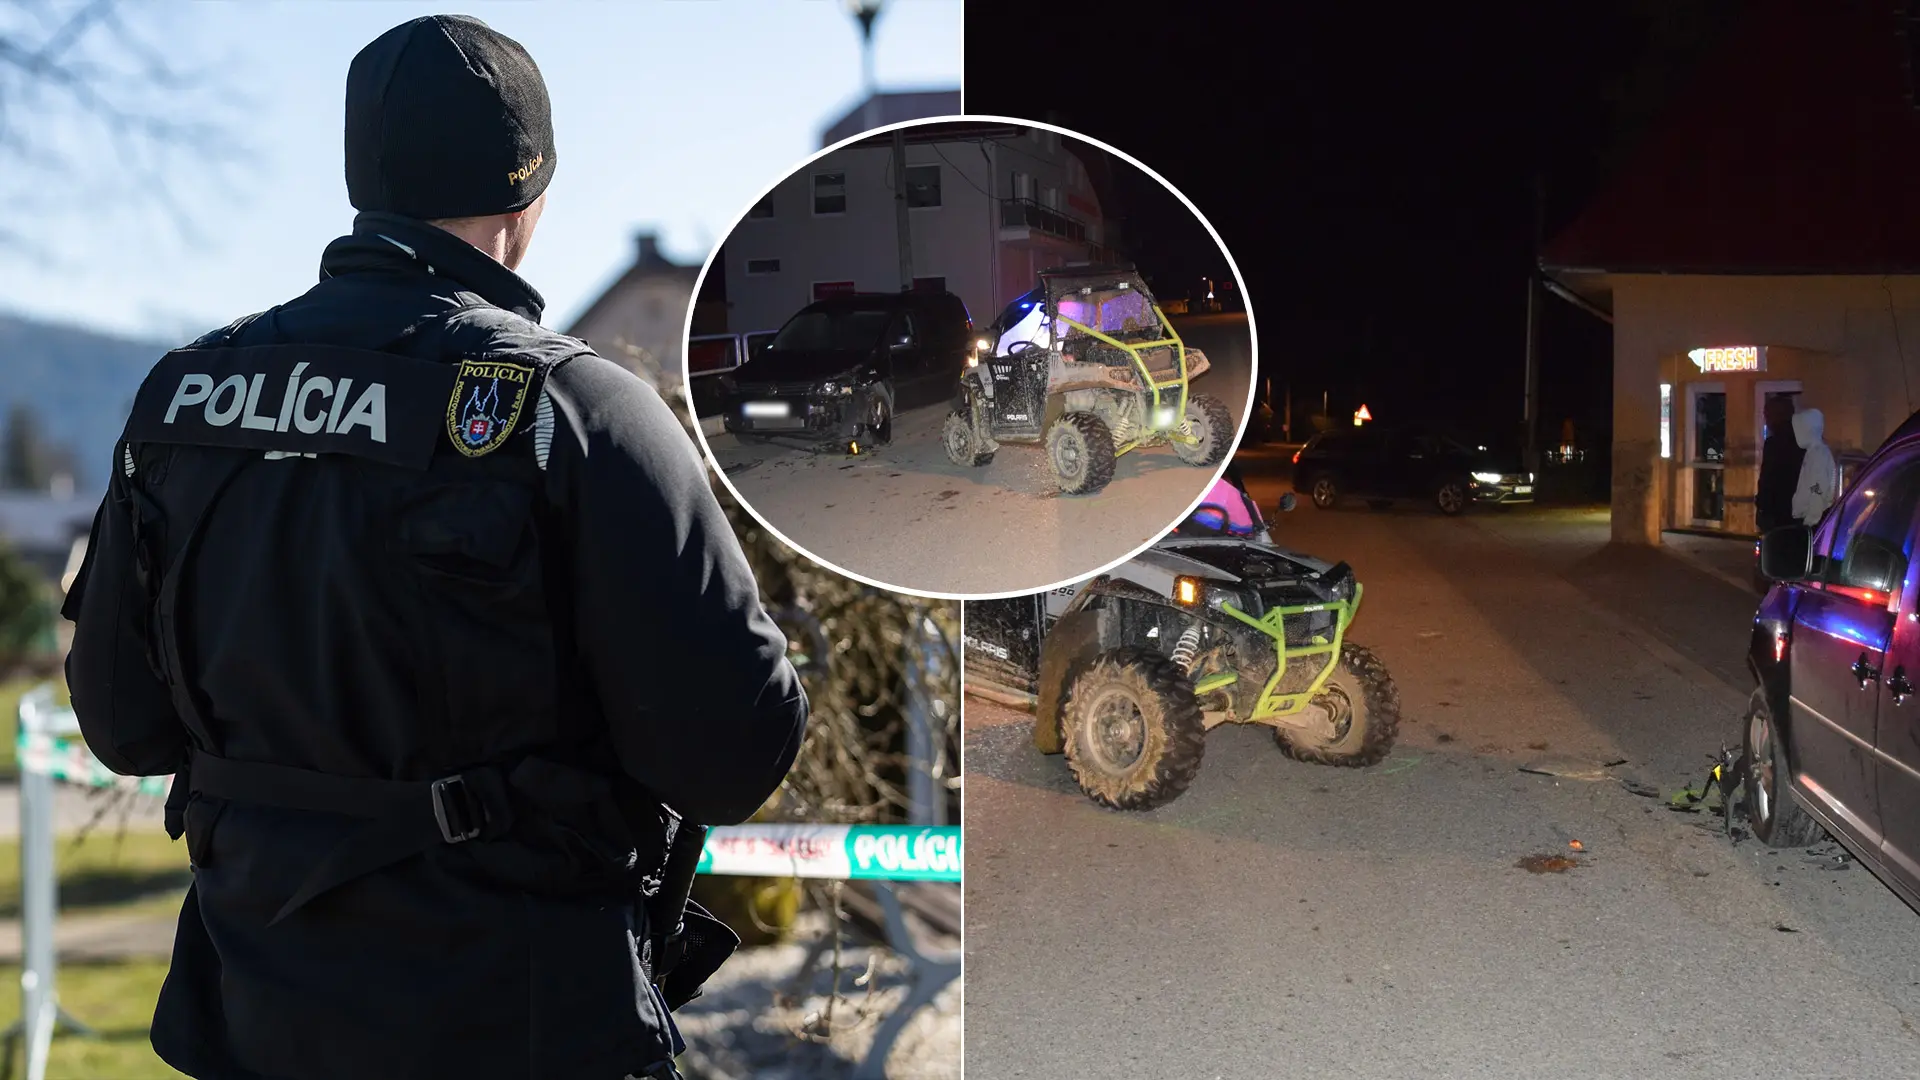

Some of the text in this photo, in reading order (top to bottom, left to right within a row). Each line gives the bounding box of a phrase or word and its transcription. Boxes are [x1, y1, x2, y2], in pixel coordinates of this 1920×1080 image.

[1705, 347, 1758, 371] FRESH
[462, 366, 525, 383] POLÍCIA
[164, 362, 386, 442] POLÍCIA
[964, 634, 1008, 660] OLARIS
[854, 829, 961, 872] POLÍCI
